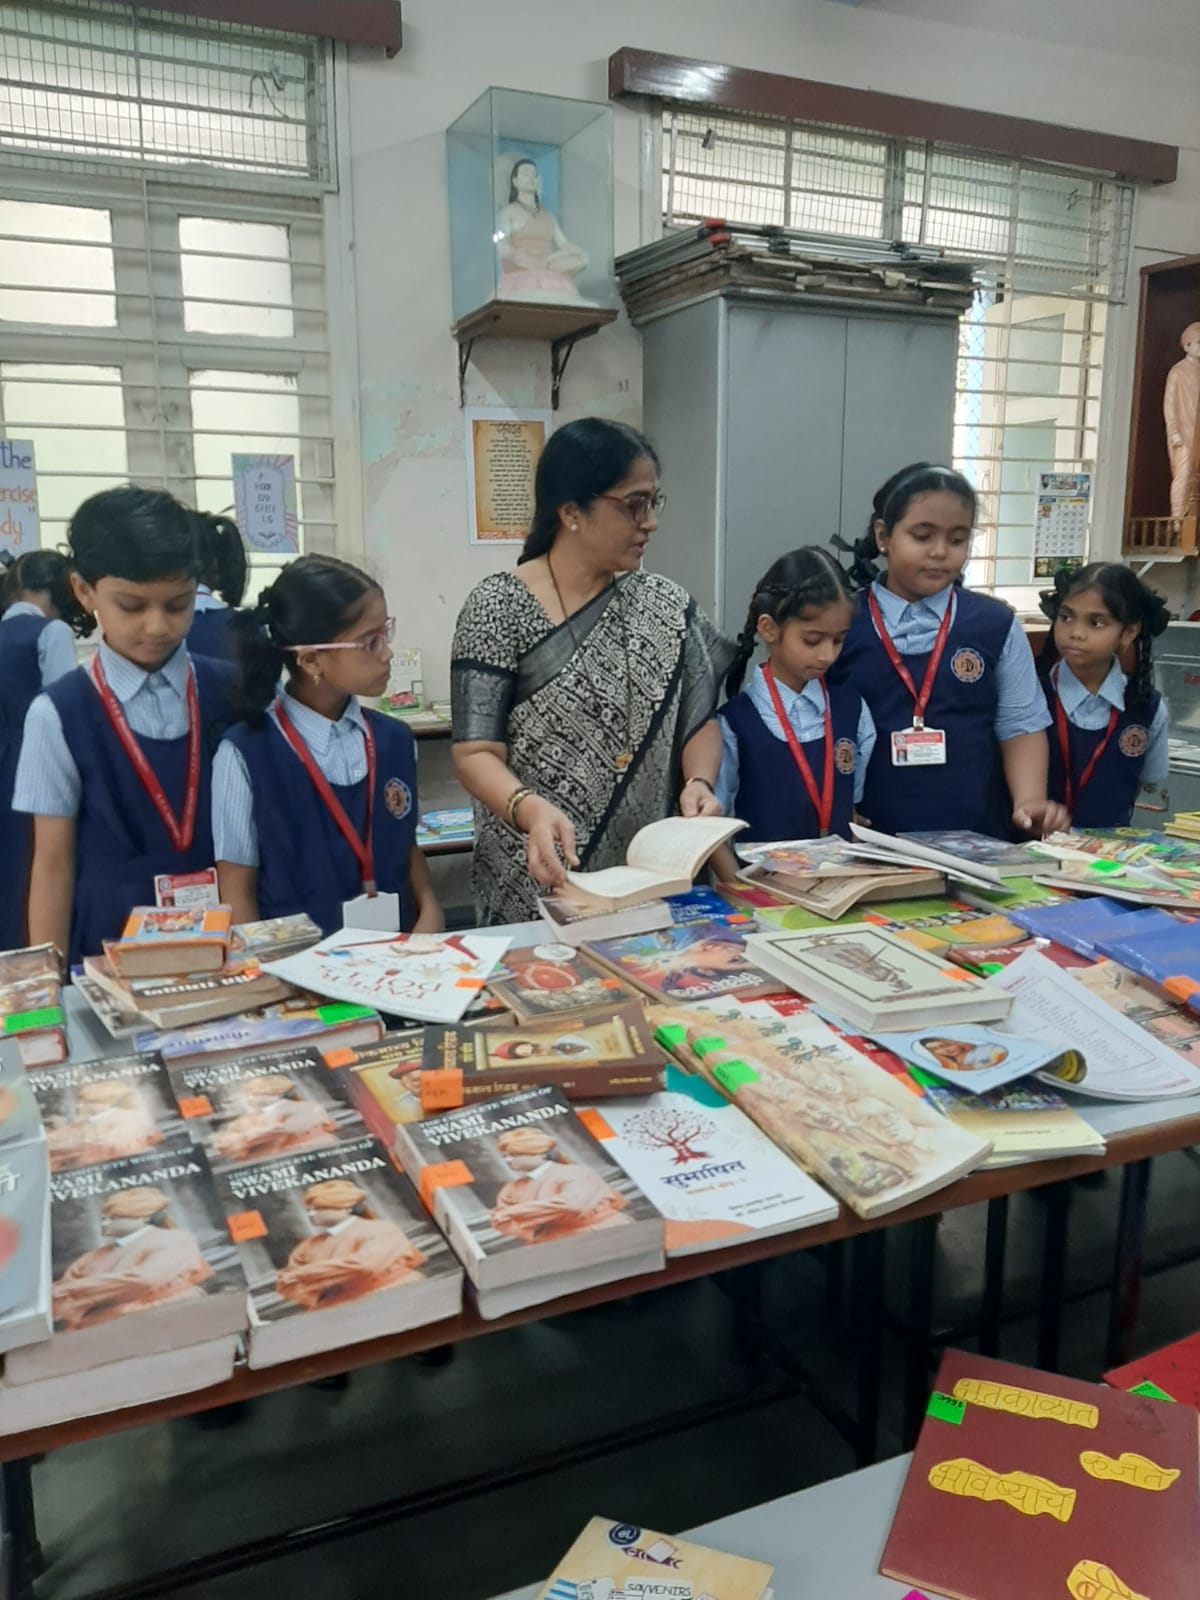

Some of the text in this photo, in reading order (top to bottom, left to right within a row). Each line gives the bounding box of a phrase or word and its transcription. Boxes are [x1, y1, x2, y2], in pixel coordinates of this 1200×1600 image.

[0, 440, 32, 469] the
[0, 485, 37, 503] rcise
[27, 1067, 80, 1086] WAMI
[31, 1063, 160, 1092] IVEKANANDA
[185, 1059, 316, 1089] VIVEKANANDA
[422, 1113, 485, 1137] SWAMI
[429, 1103, 568, 1146] VIVEKANANDA
[50, 1172, 103, 1192] WAMI
[229, 1165, 298, 1190] SWAMI
[232, 1157, 386, 1199] VIVEKANANDA
[659, 1160, 746, 1189] सुभाषित
